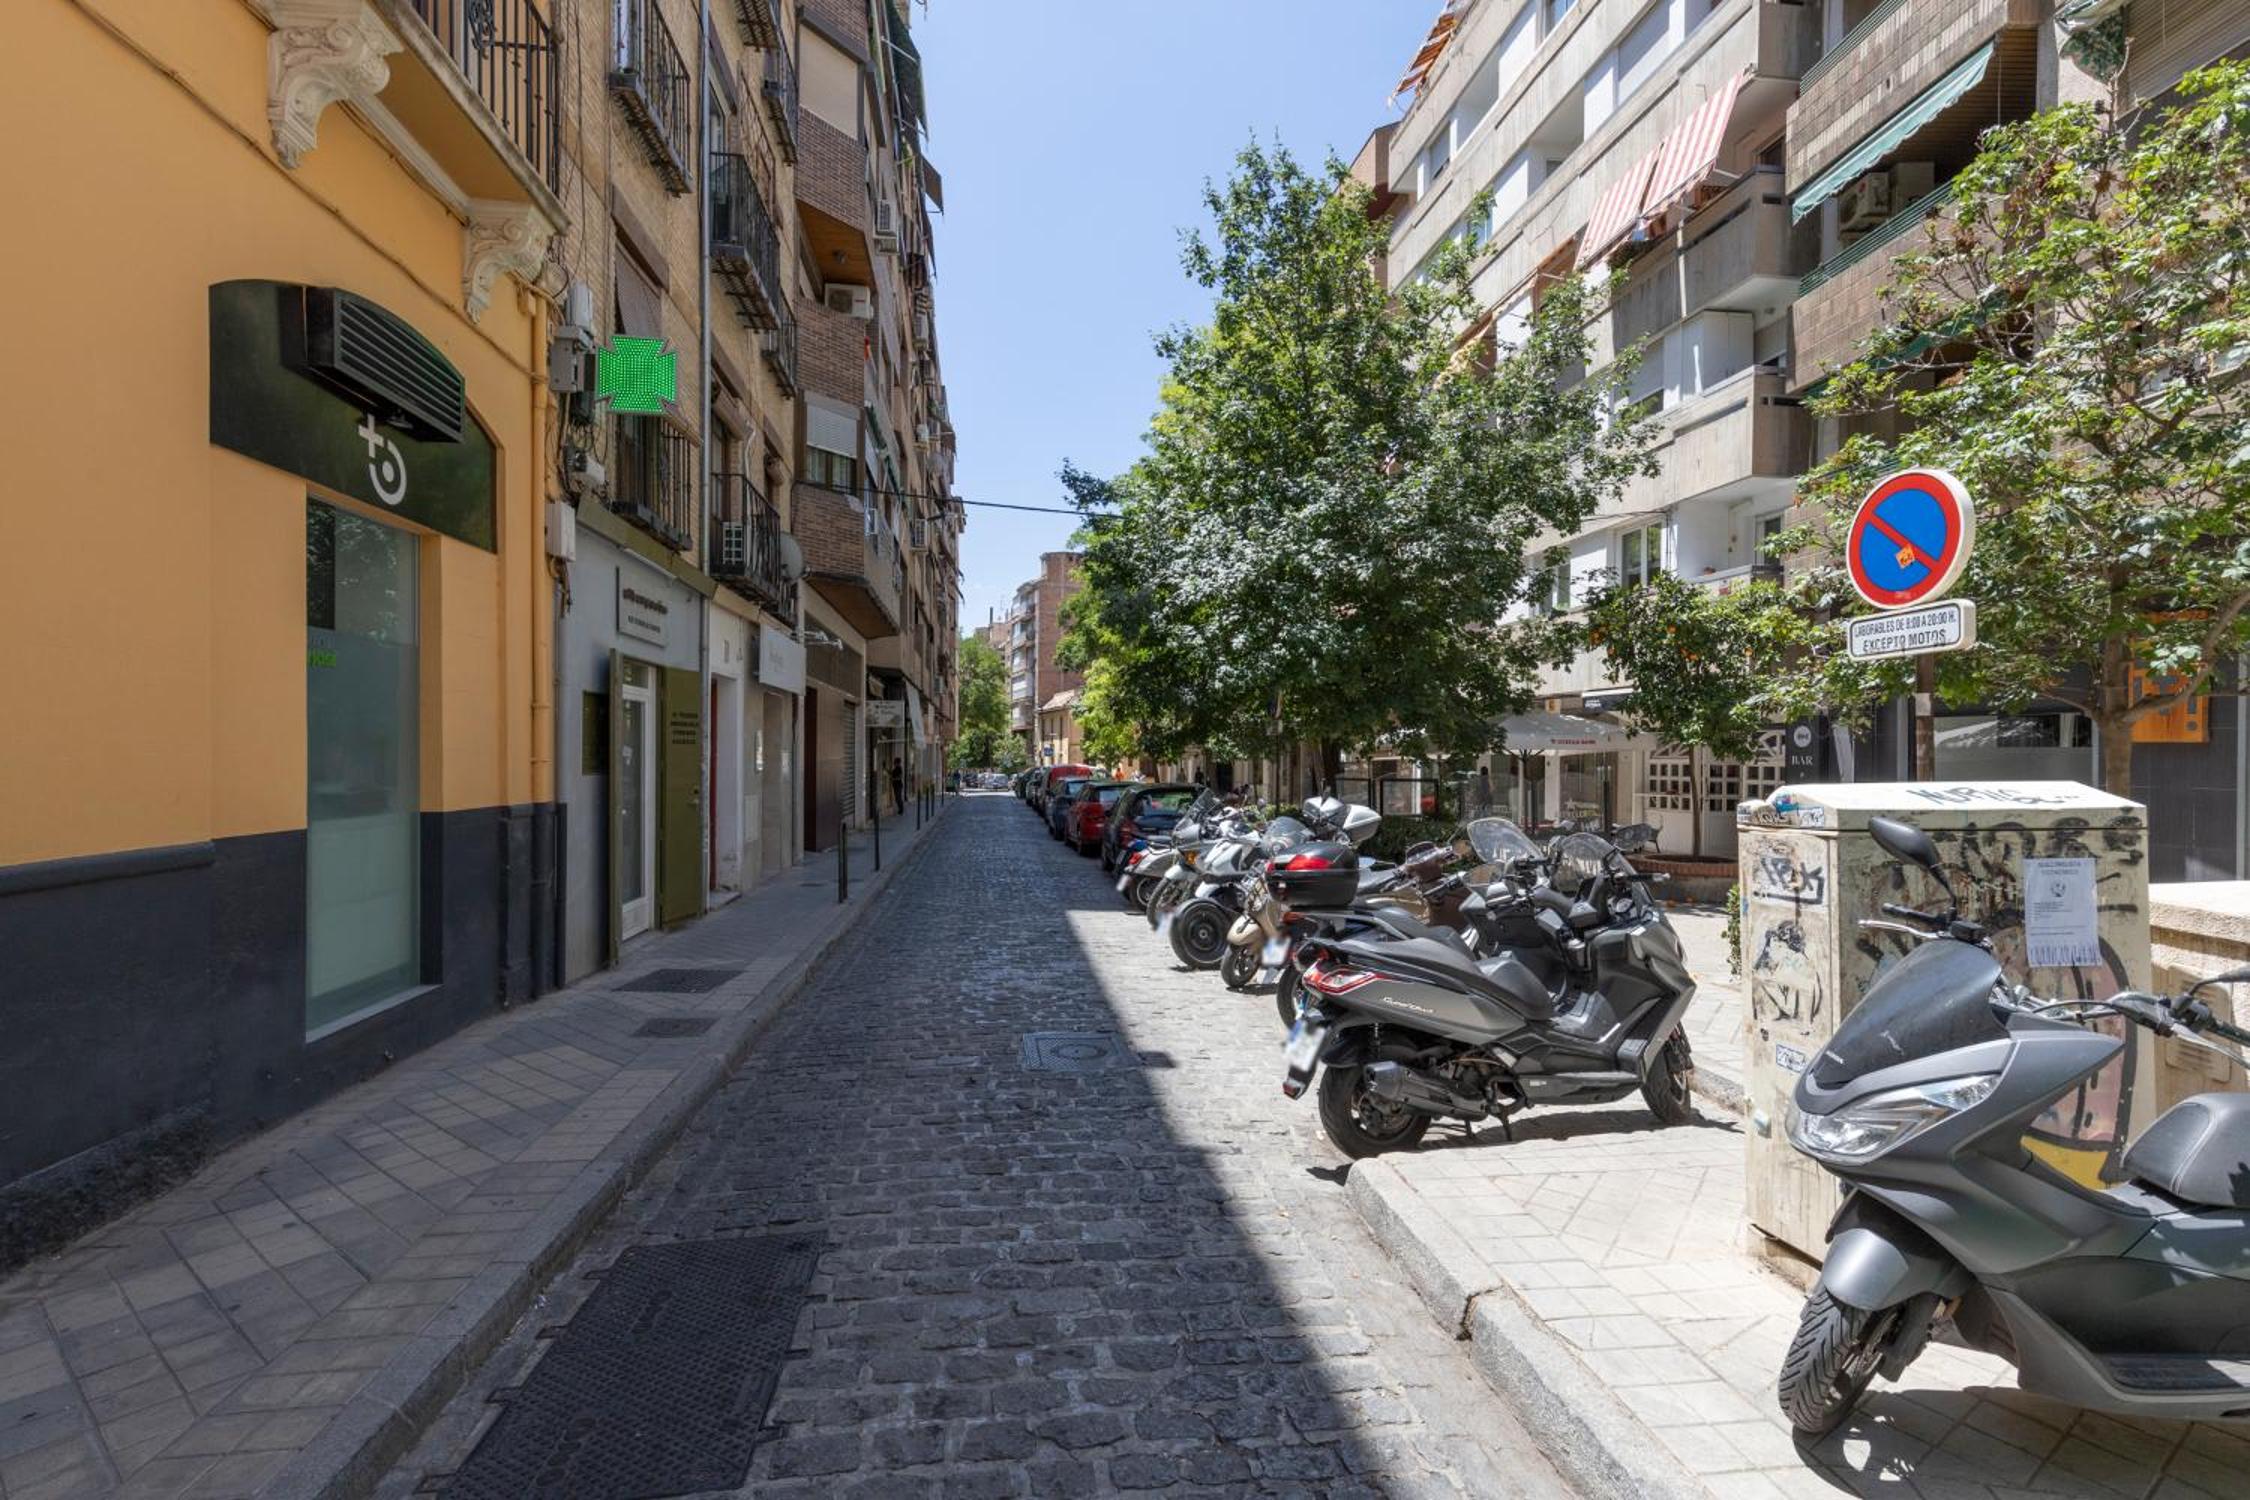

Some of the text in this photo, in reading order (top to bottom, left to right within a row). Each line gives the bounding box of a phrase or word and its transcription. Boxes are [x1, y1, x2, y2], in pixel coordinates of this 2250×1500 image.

[1855, 621, 1895, 638] LABORABLES
[1896, 619, 1904, 631] DE
[1920, 616, 1927, 627] A
[1927, 612, 1947, 627] 20:00
[1863, 629, 1946, 652] EXCEPTO MOTOS
